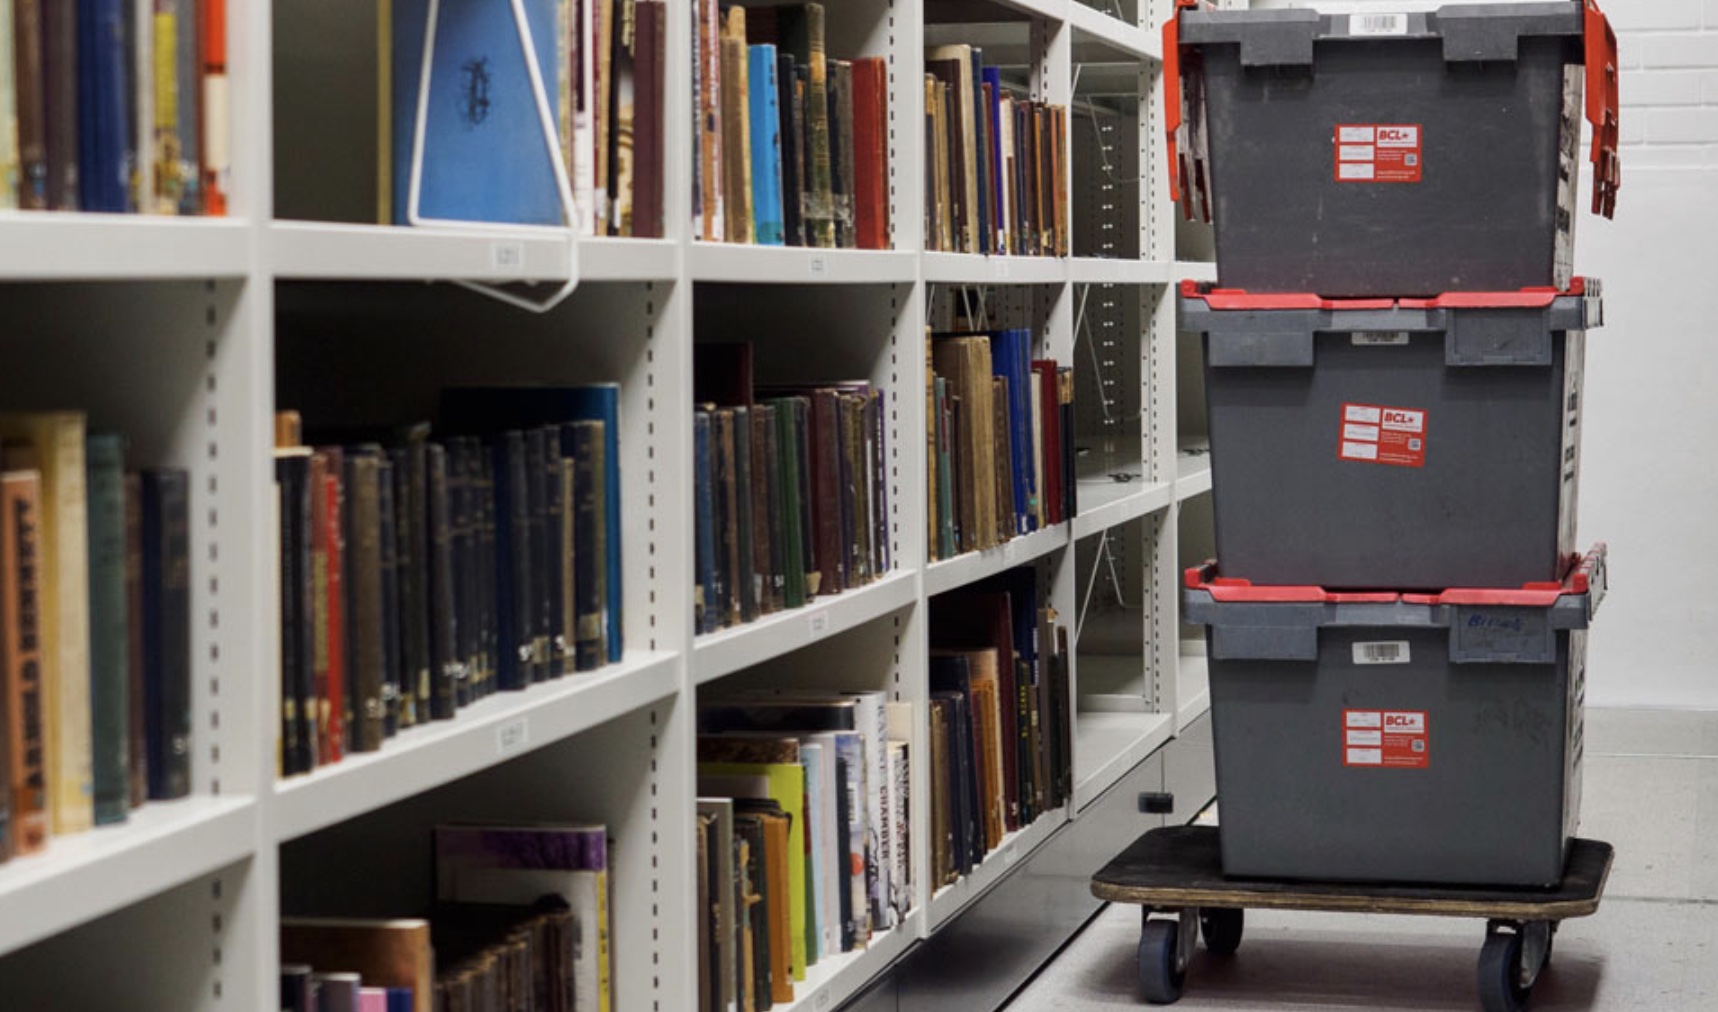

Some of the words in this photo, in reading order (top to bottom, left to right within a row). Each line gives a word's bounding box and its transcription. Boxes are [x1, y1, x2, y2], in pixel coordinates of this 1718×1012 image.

[1379, 130, 1401, 140] BCL
[1384, 412, 1408, 423] BCL
[1385, 715, 1408, 726] BCL
